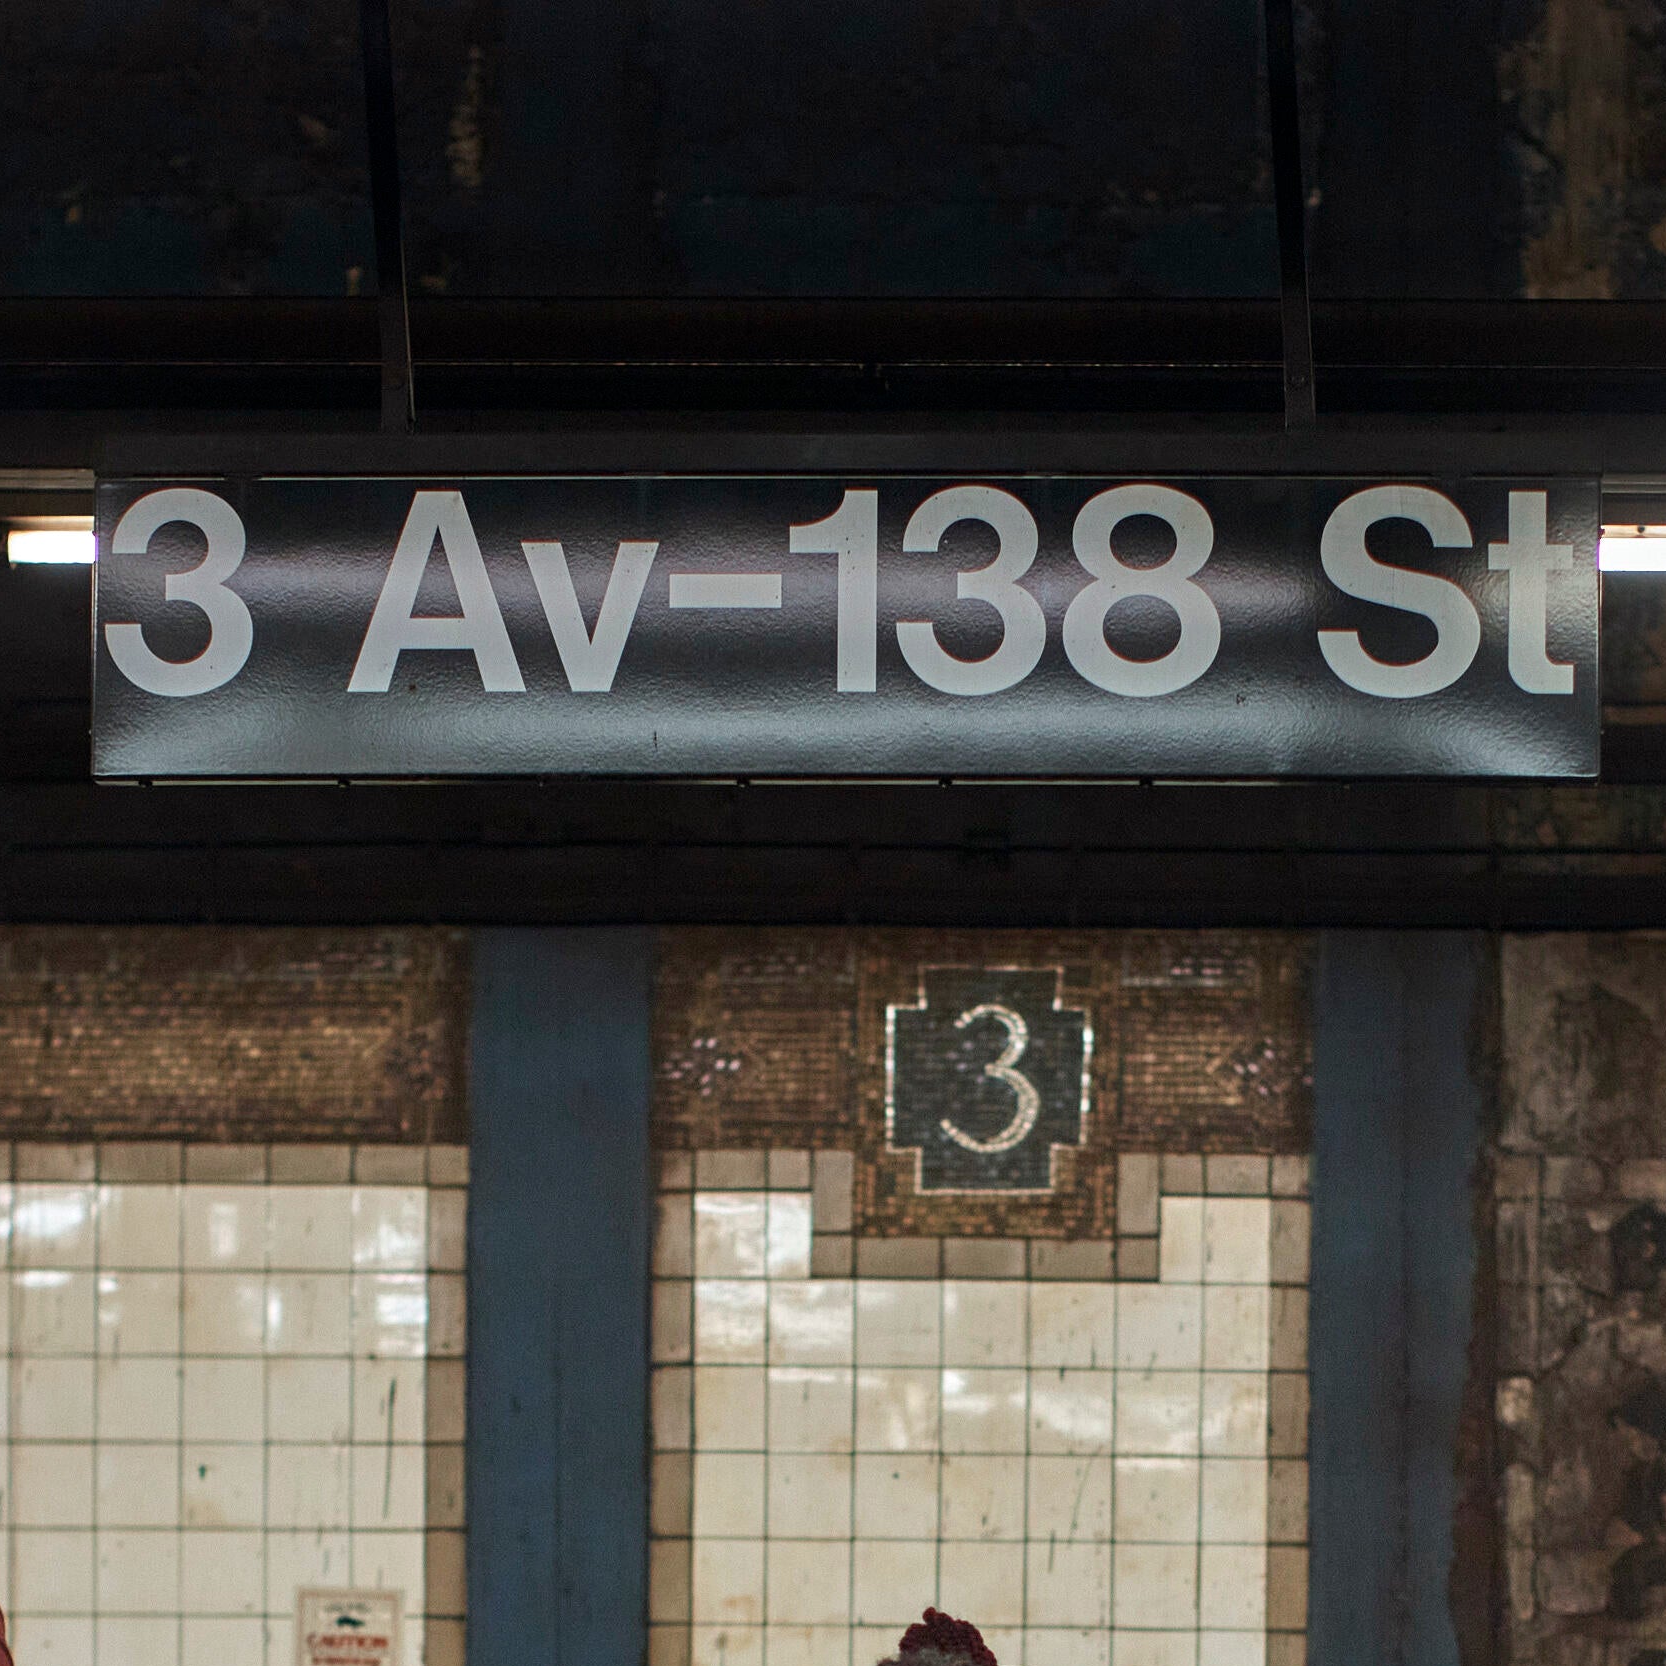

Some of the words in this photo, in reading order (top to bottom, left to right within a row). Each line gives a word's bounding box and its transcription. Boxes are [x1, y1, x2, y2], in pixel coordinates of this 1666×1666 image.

[105, 487, 255, 698] 3
[1317, 484, 1575, 699] St
[940, 1004, 1042, 1153] 3
